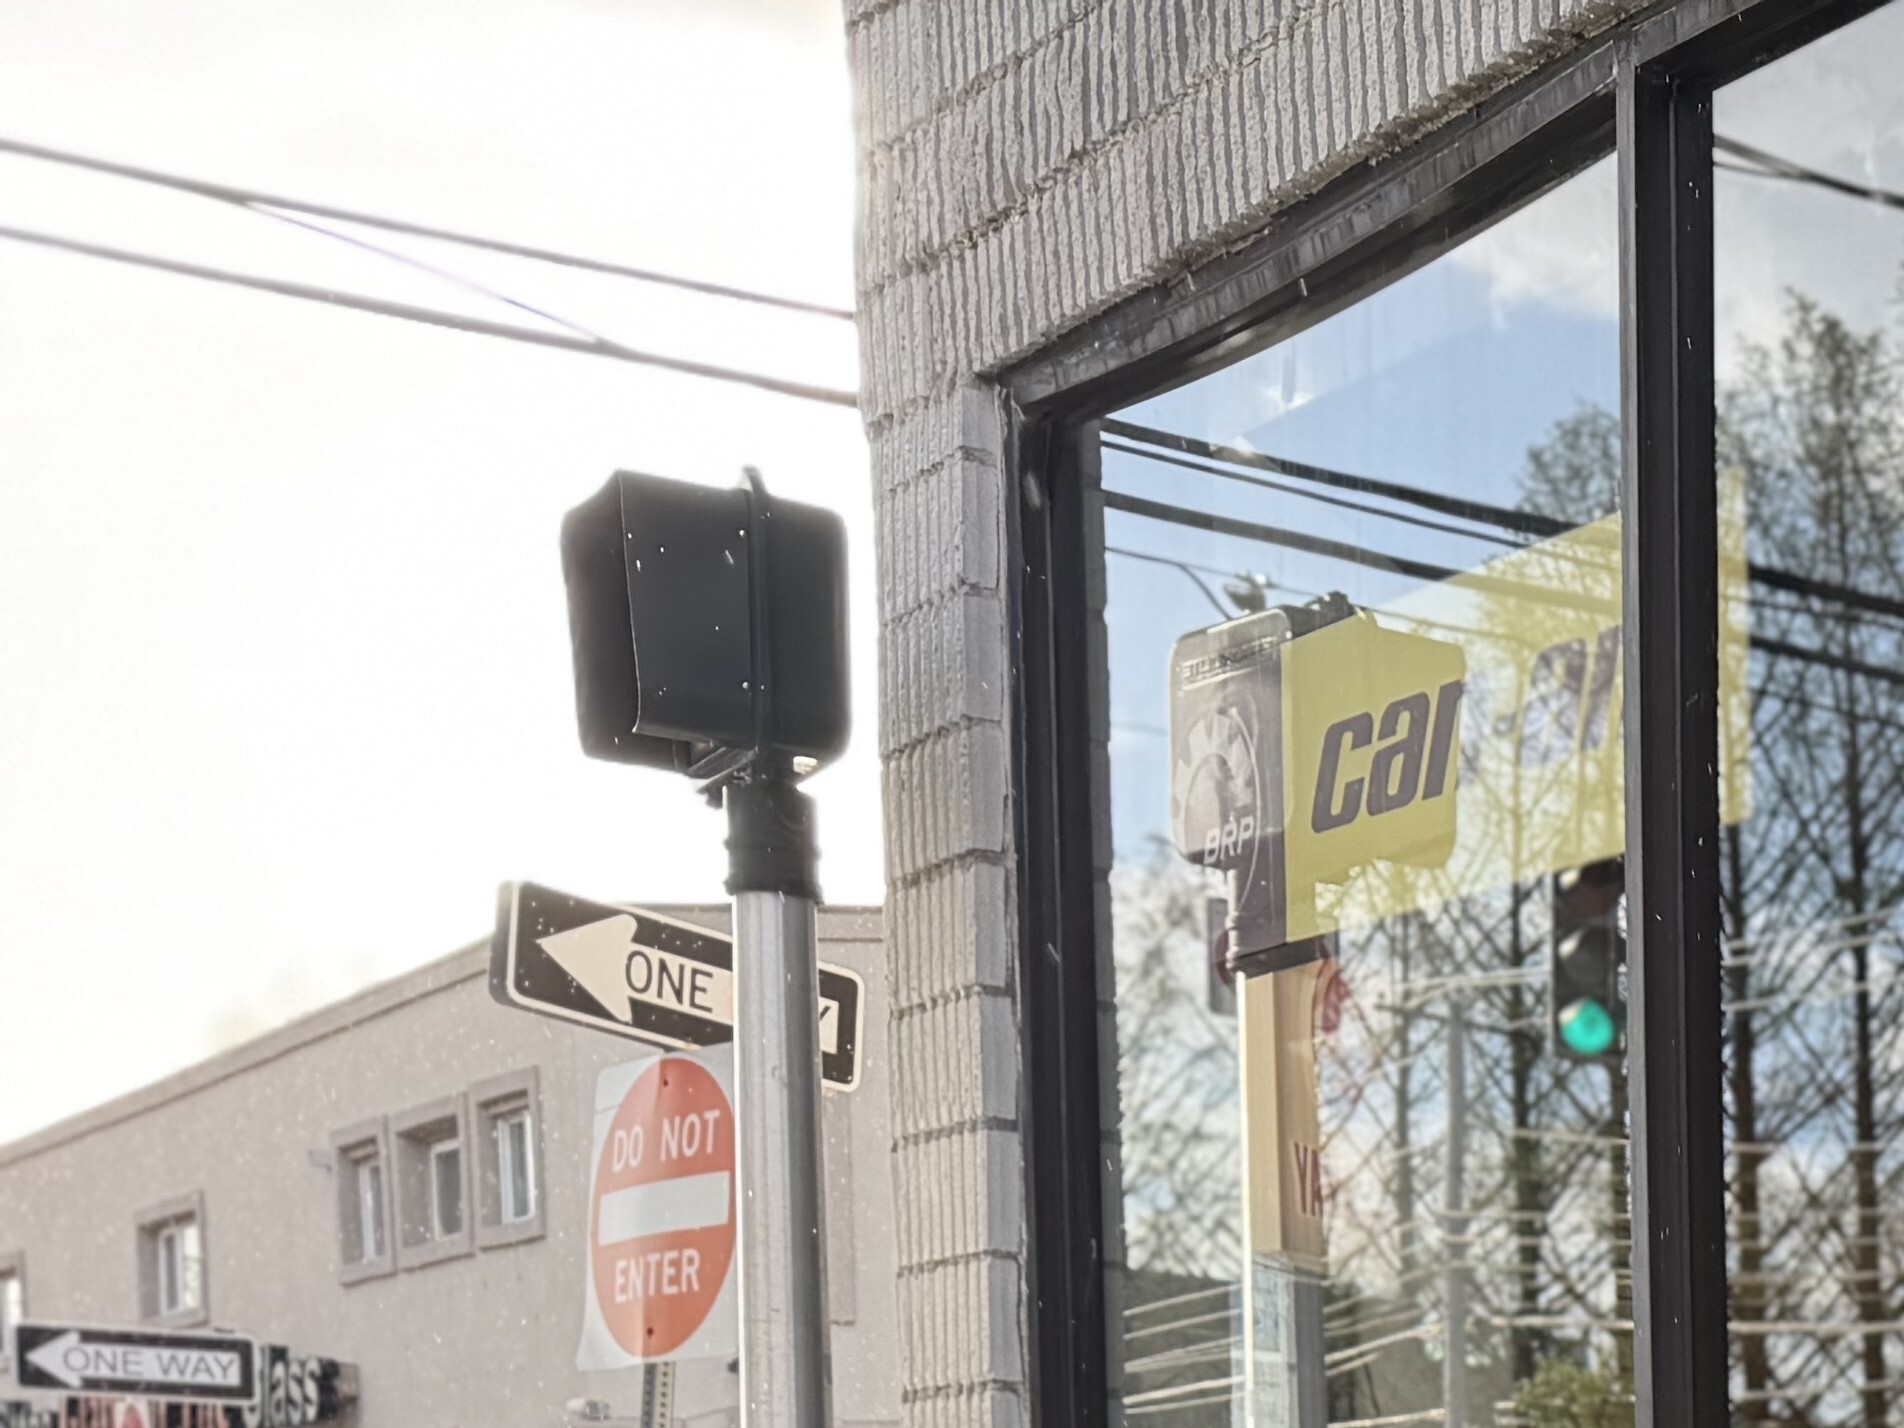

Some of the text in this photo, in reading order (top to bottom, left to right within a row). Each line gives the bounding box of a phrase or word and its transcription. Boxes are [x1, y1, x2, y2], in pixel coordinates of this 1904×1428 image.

[625, 950, 713, 1013] ONE
[613, 1110, 720, 1173] DO NOT
[615, 1249, 700, 1304] ENTER
[63, 1348, 235, 1382] ONE WAY
